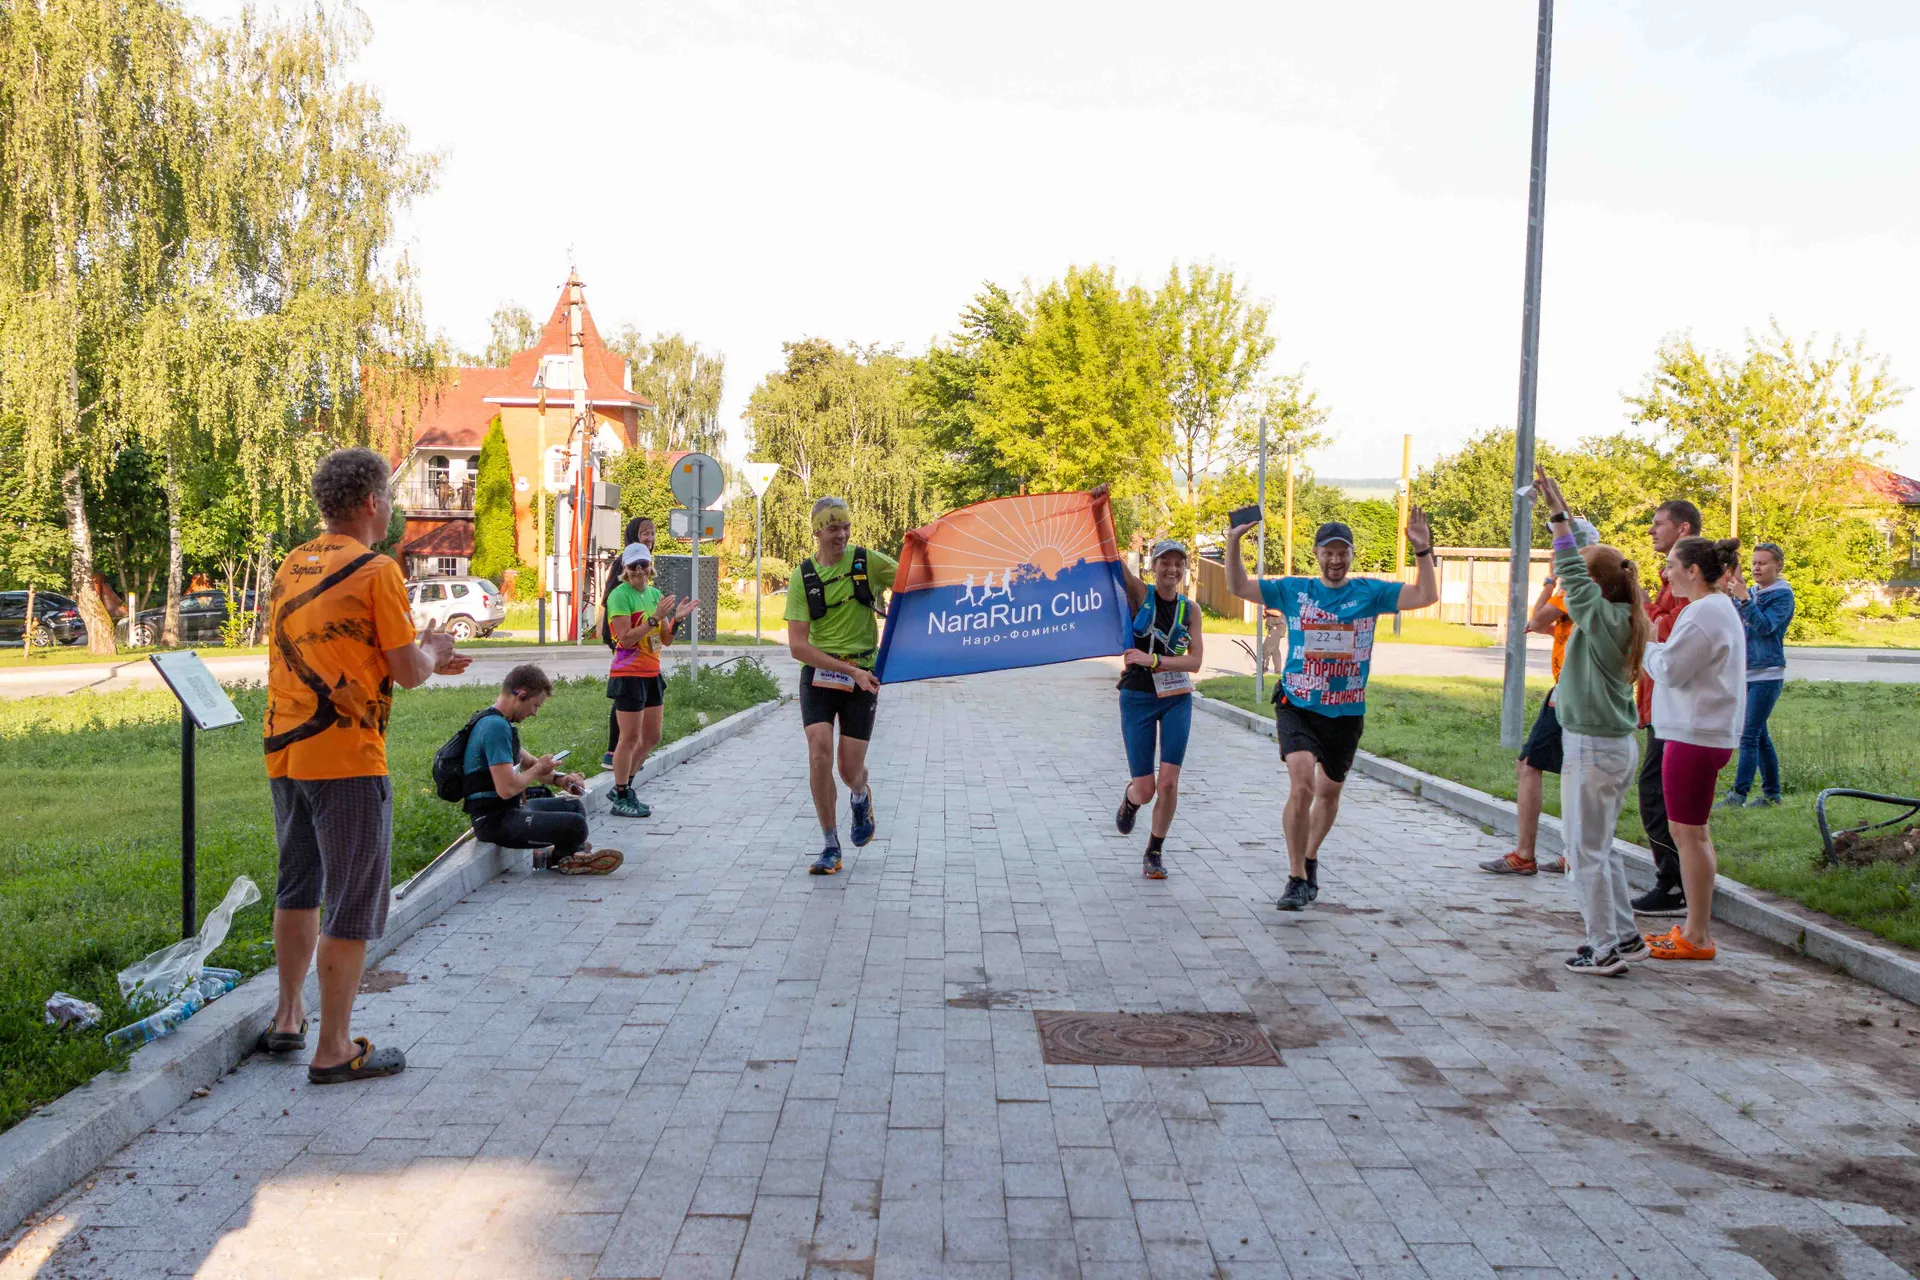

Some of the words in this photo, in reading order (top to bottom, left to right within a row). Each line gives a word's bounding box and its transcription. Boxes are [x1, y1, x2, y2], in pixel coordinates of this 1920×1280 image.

[927, 602, 1042, 635] NaraRun
[1051, 587, 1102, 617] Club
[962, 621, 1076, 646] Наро-Фоминск
[1316, 632, 1342, 642] 22-4
[1303, 660, 1360, 677] #ГОРДОСТЬ
